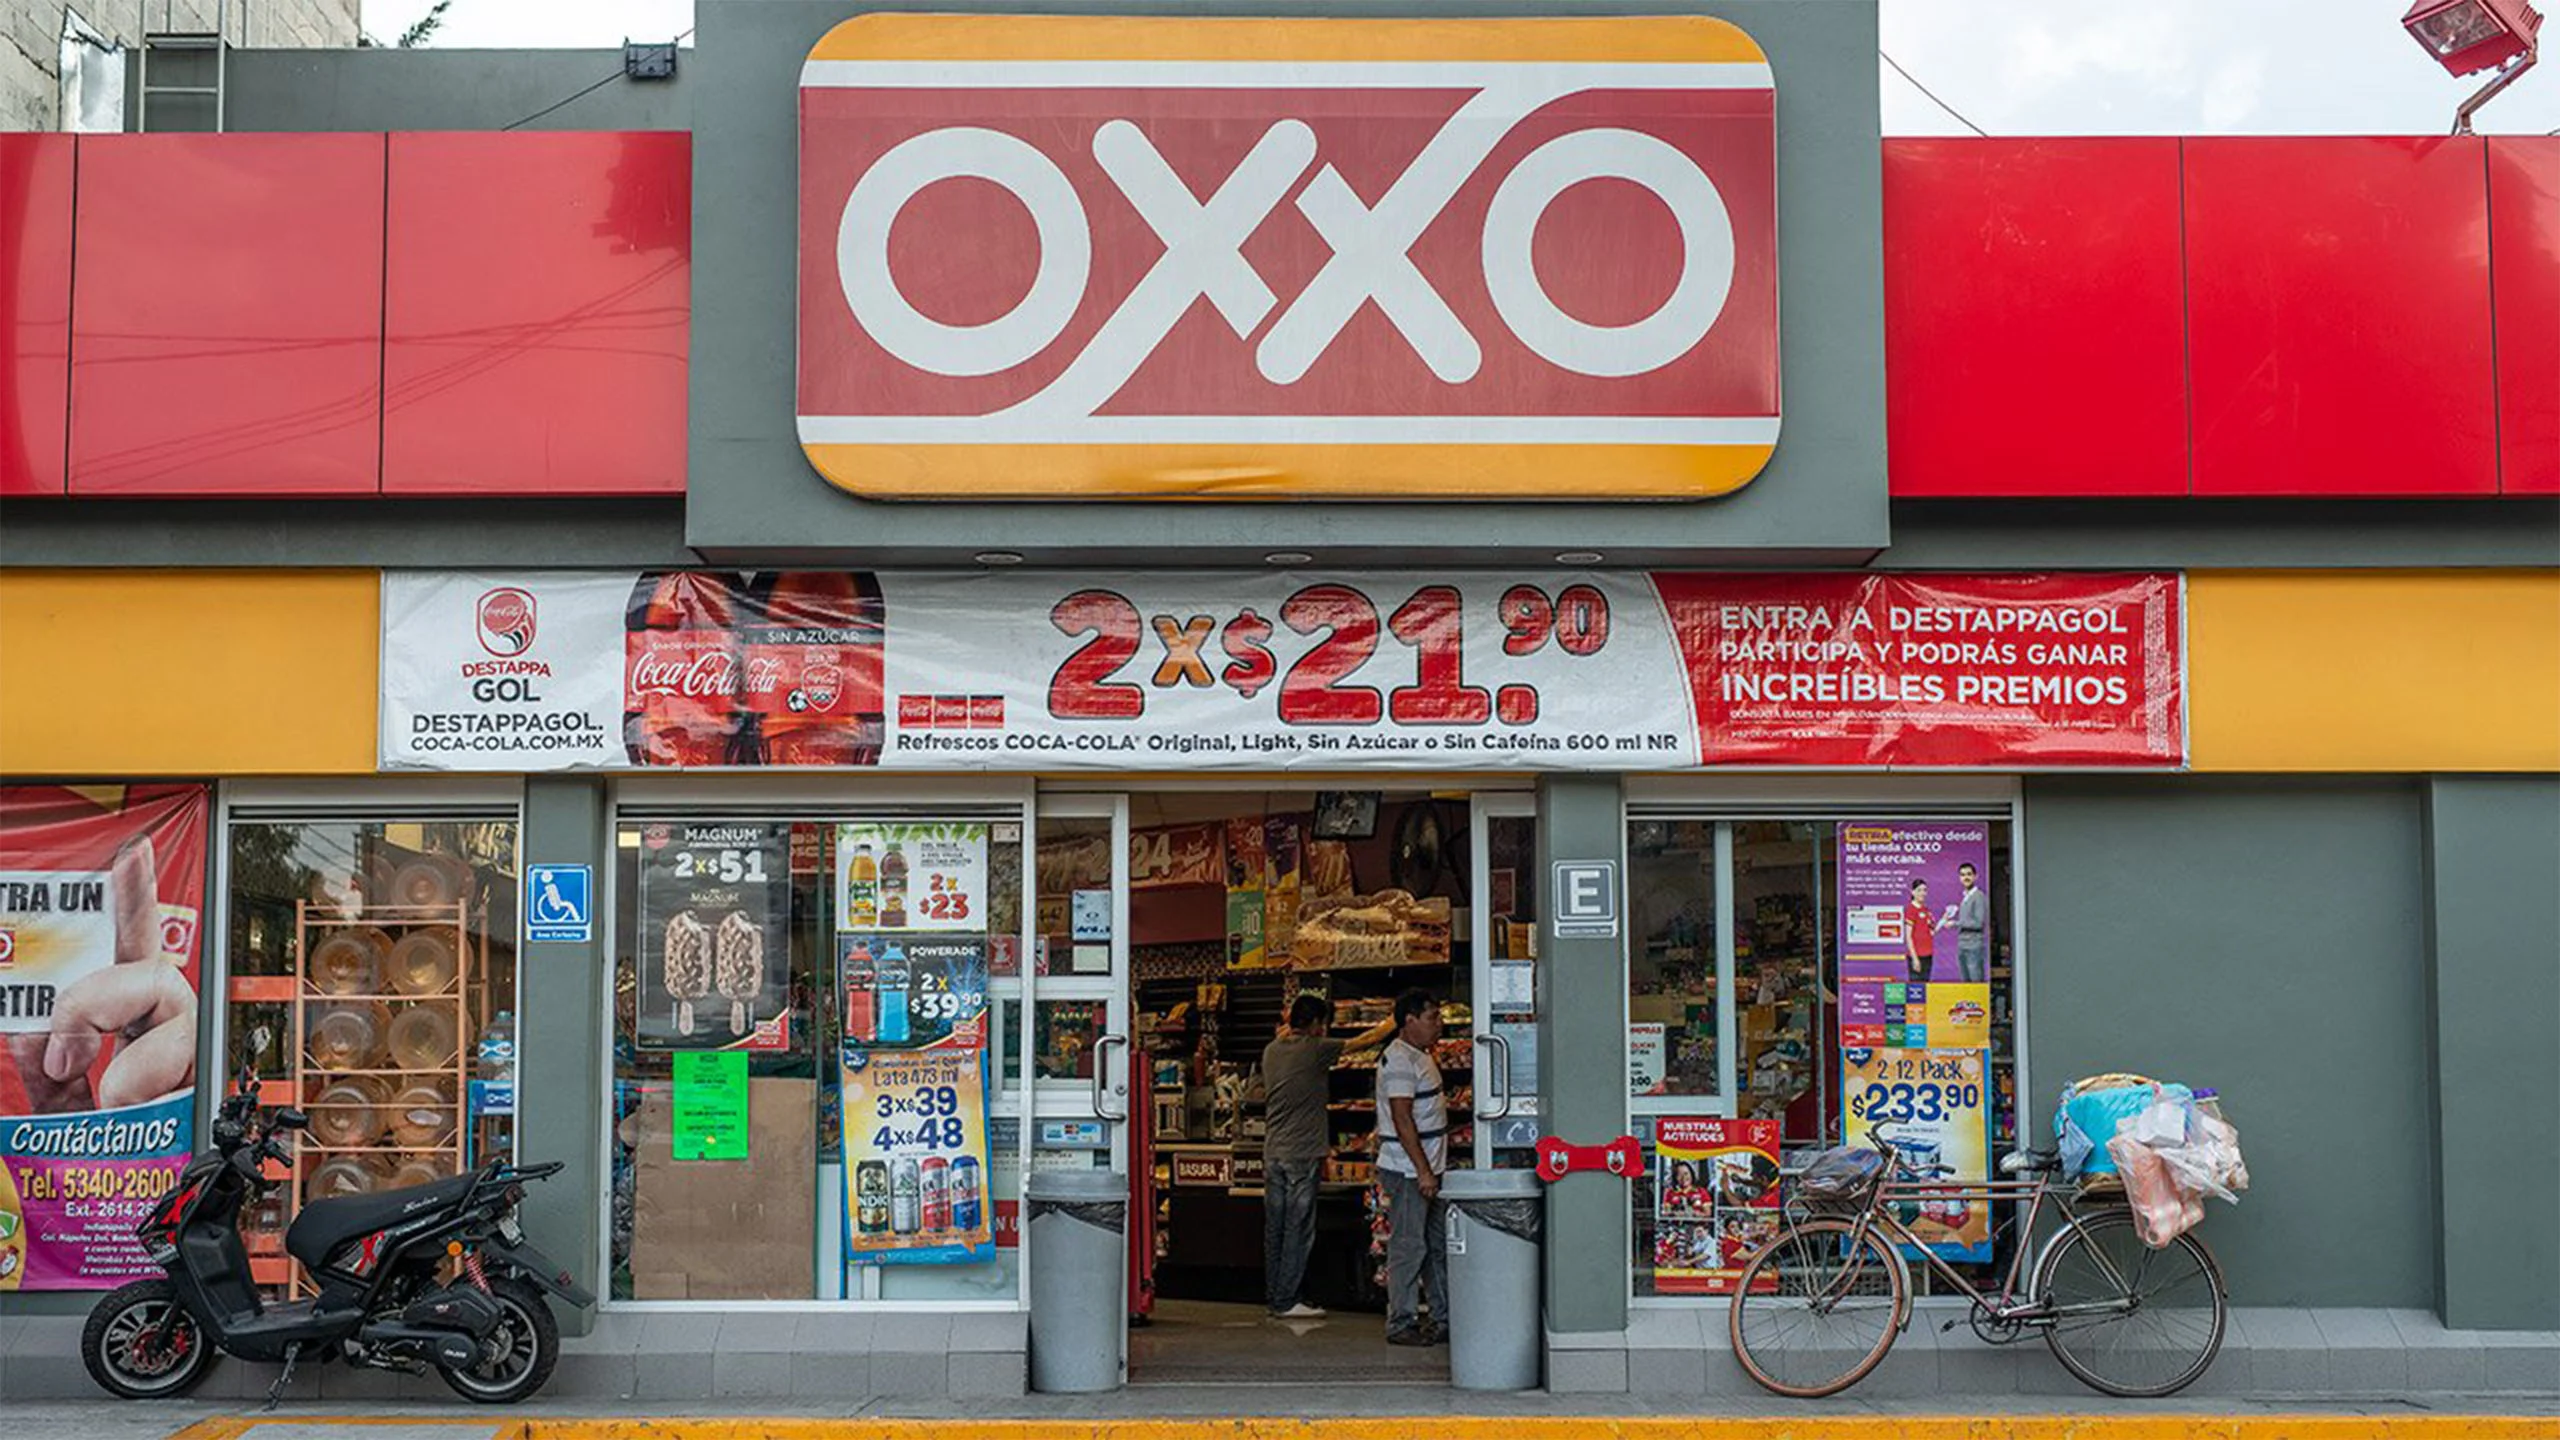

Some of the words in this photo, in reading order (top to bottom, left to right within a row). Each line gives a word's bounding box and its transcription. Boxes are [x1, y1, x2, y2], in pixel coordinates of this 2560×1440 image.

[837, 88, 1734, 416] OXXO
[1720, 606, 1833, 630] ENTRA
[1851, 606, 1873, 630] A
[1889, 607, 2128, 633] DESTAPPAGOL
[768, 631, 791, 643] SIN
[795, 628, 861, 643] AZÚCAR
[1721, 641, 1865, 662] PARTICIPA
[1873, 641, 1893, 662] Y
[1902, 638, 2017, 664] PODRÁS
[2027, 644, 2128, 665] GANAR
[462, 661, 552, 678] DESTAPPA
[632, 651, 738, 697] Coca-Cola
[472, 678, 542, 703] GOL
[1722, 666, 1944, 703] INCREÍBLES
[1957, 676, 2128, 705] PREMIOS
[413, 712, 604, 733] DESTAPPAGOL.
[411, 735, 604, 751] COCA-COLA.COM.MX
[897, 734, 999, 750] Refrescos
[1147, 735, 1236, 753] Original,
[1242, 734, 1302, 753] Light,
[1308, 734, 1339, 749] Sin
[1346, 734, 1419, 750] Azúcar
[1425, 737, 1438, 750] o
[1444, 734, 1476, 750] Sin
[1566, 735, 1609, 750] 600
[1616, 735, 1641, 750] ml
[1647, 735, 1678, 750] NR
[1892, 831, 1943, 840] efectivo
[1945, 831, 1983, 840] desde
[1846, 843, 1859, 852] tu
[1862, 842, 1901, 852] tienda
[1903, 842, 1942, 852] OXXO
[1846, 853, 1872, 863] más
[58, 882, 103, 912] UN
[1569, 870, 1601, 914] E
[920, 894, 969, 920] $23
[910, 946, 977, 957] POWERADE
[910, 992, 982, 1019] $39.90
[873, 1069, 909, 1087] Lata
[910, 1068, 938, 1085] 473
[1877, 1060, 1889, 1080] 2
[1896, 1060, 1915, 1080] 12
[1921, 1060, 1964, 1080] Pack
[1852, 1083, 1979, 1121] $233.90
[11, 1118, 179, 1156] Contáctanos
[1663, 1122, 1722, 1131] NUESTRAS
[1663, 1131, 1726, 1143] ACTITUDES
[20, 1168, 57, 1199] Tel.
[66, 1203, 94, 1217] Ext.
